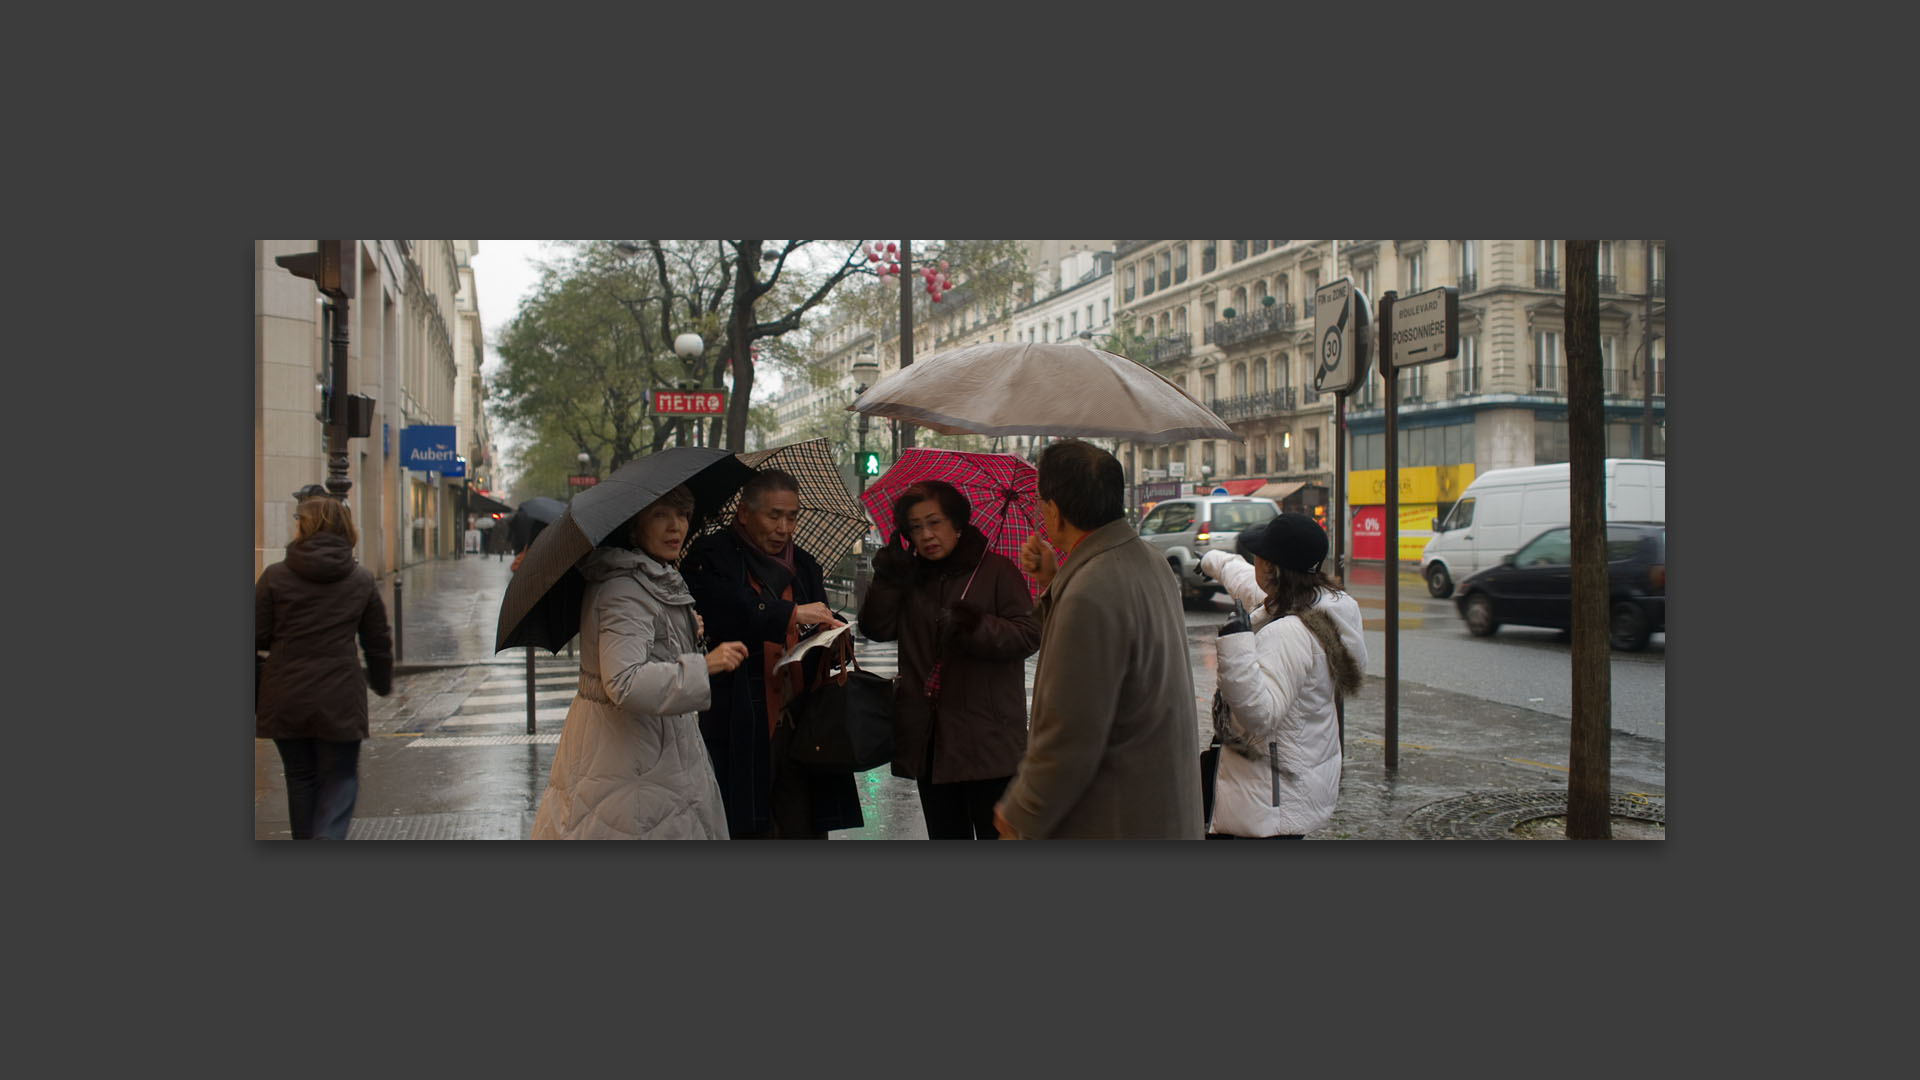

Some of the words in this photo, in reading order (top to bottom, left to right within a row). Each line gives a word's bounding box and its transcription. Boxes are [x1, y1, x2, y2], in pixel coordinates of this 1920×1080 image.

[1318, 294, 1327, 304] FIN
[1332, 286, 1347, 300] ZONE
[1399, 300, 1438, 319] BOULEVARD
[1392, 320, 1445, 345] POISSONNIÈRE
[1326, 339, 1338, 358] 30
[410, 447, 454, 461] Aubert
